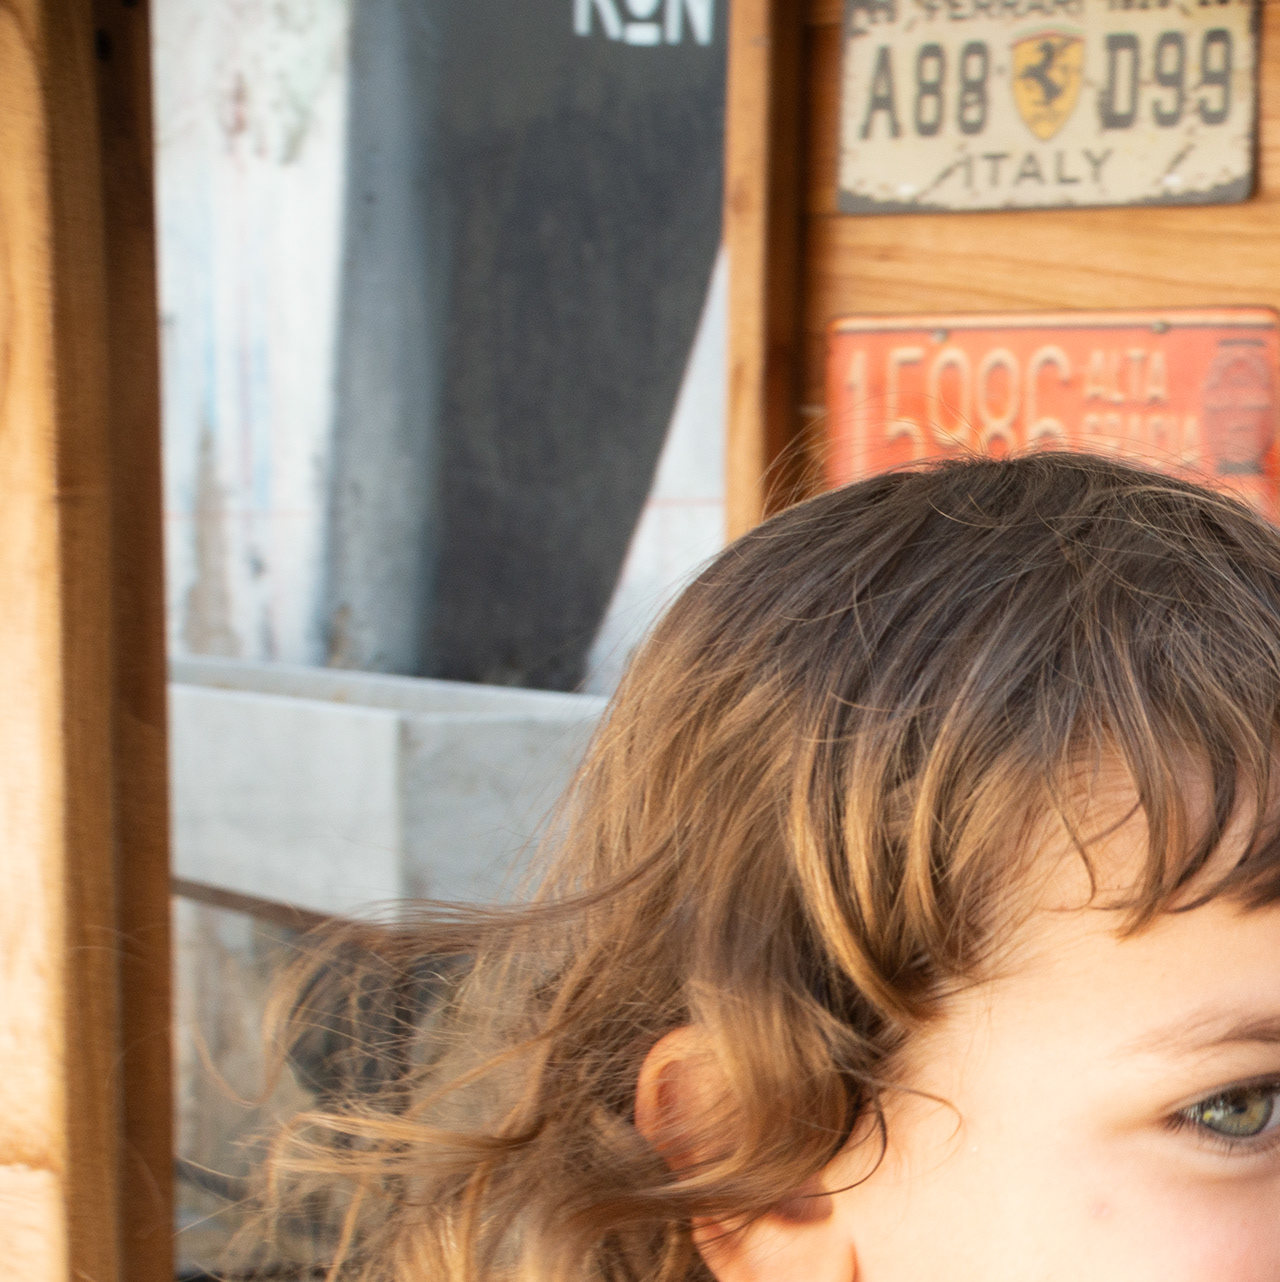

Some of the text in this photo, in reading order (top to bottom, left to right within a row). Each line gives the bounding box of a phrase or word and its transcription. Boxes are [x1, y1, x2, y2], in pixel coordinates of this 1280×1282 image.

[859, 28, 1234, 141] A88 D99
[960, 149, 1117, 189] ITALY
